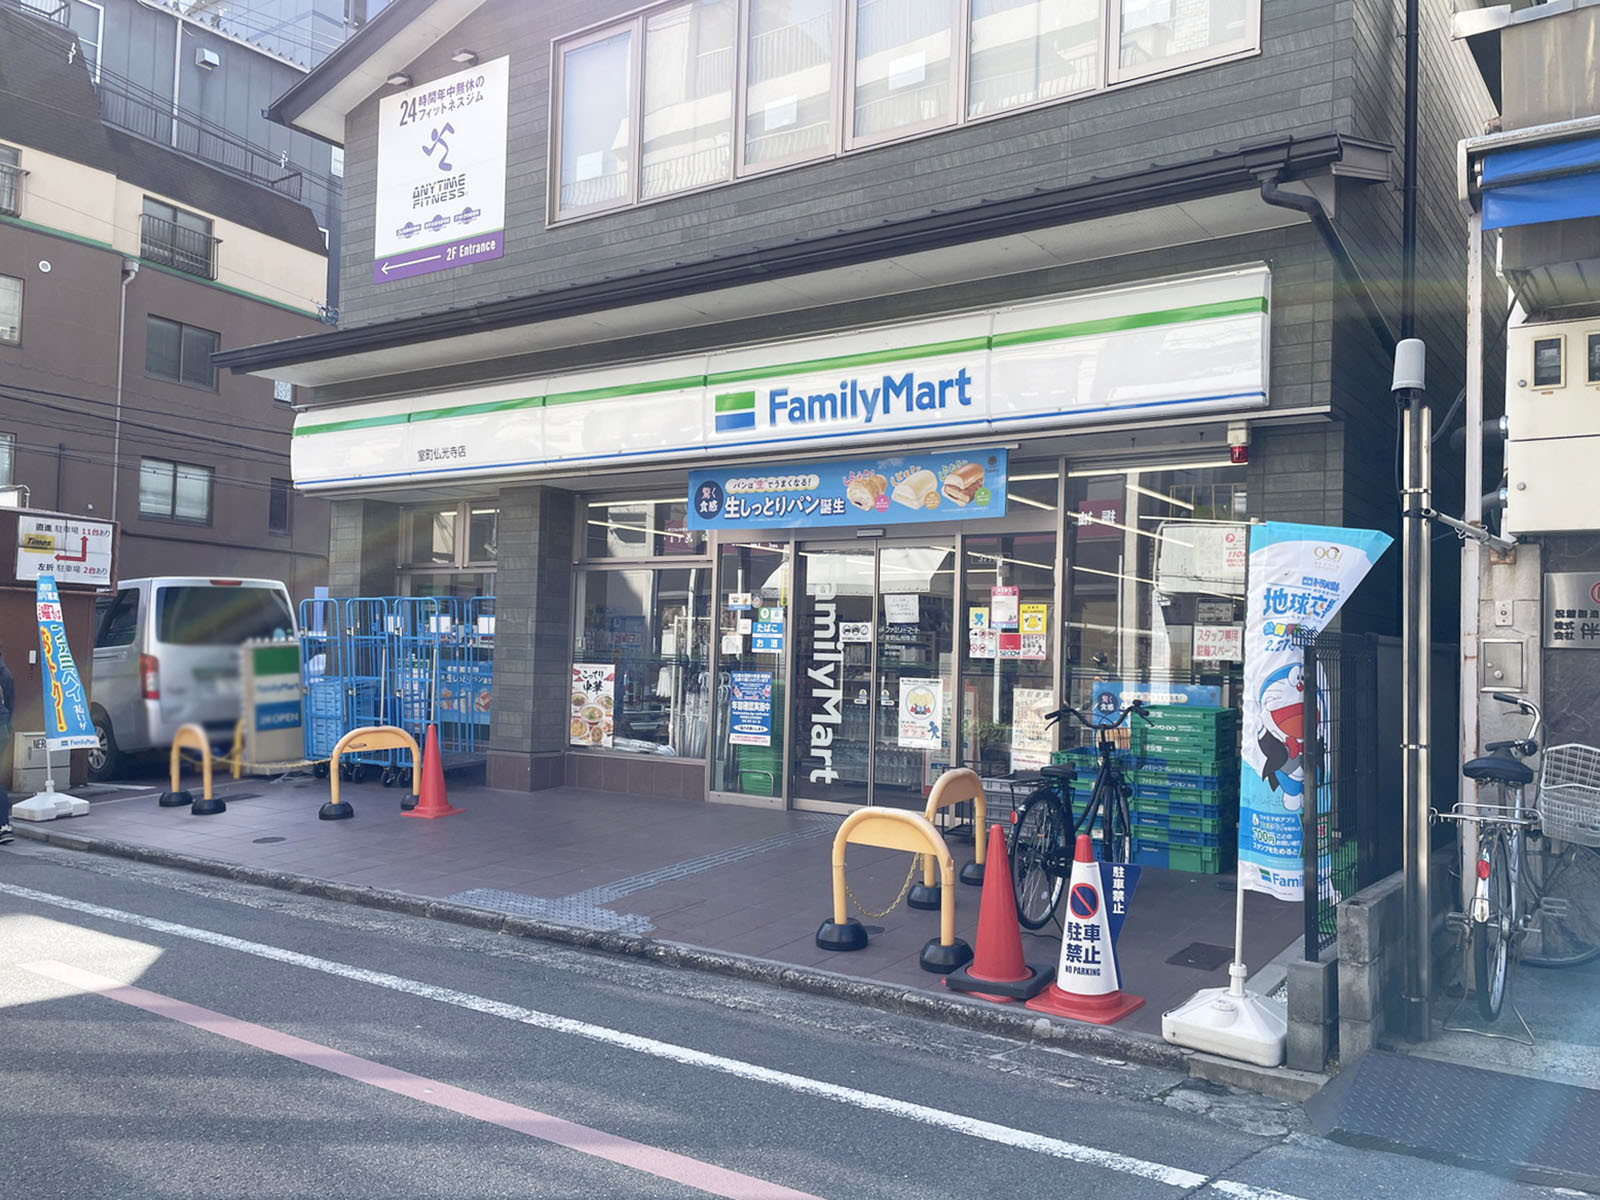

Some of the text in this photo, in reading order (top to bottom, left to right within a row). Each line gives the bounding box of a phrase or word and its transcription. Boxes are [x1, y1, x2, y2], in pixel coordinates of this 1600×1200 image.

[400, 75, 485, 127] 24 時間年中無休の
[418, 91, 483, 121] フィットネスジム
[412, 173, 466, 199] ANYTIME
[413, 187, 465, 210] FITNESS
[446, 239, 496, 261] 2F Entrance
[769, 367, 972, 427] FamilyMart
[417, 445, 467, 462] 室町仏光寺店
[700, 501, 719, 513] 食感
[724, 496, 845, 519] 生しっとりパン誕生
[27, 537, 52, 547] Times
[38, 563, 54, 571] 左折
[757, 623, 778, 633] たばこ
[1112, 866, 1125, 915] 駐車禁止
[1067, 921, 1101, 943] 駐車
[1066, 943, 1101, 964] 禁止
[1065, 965, 1101, 977] NO PARKING
